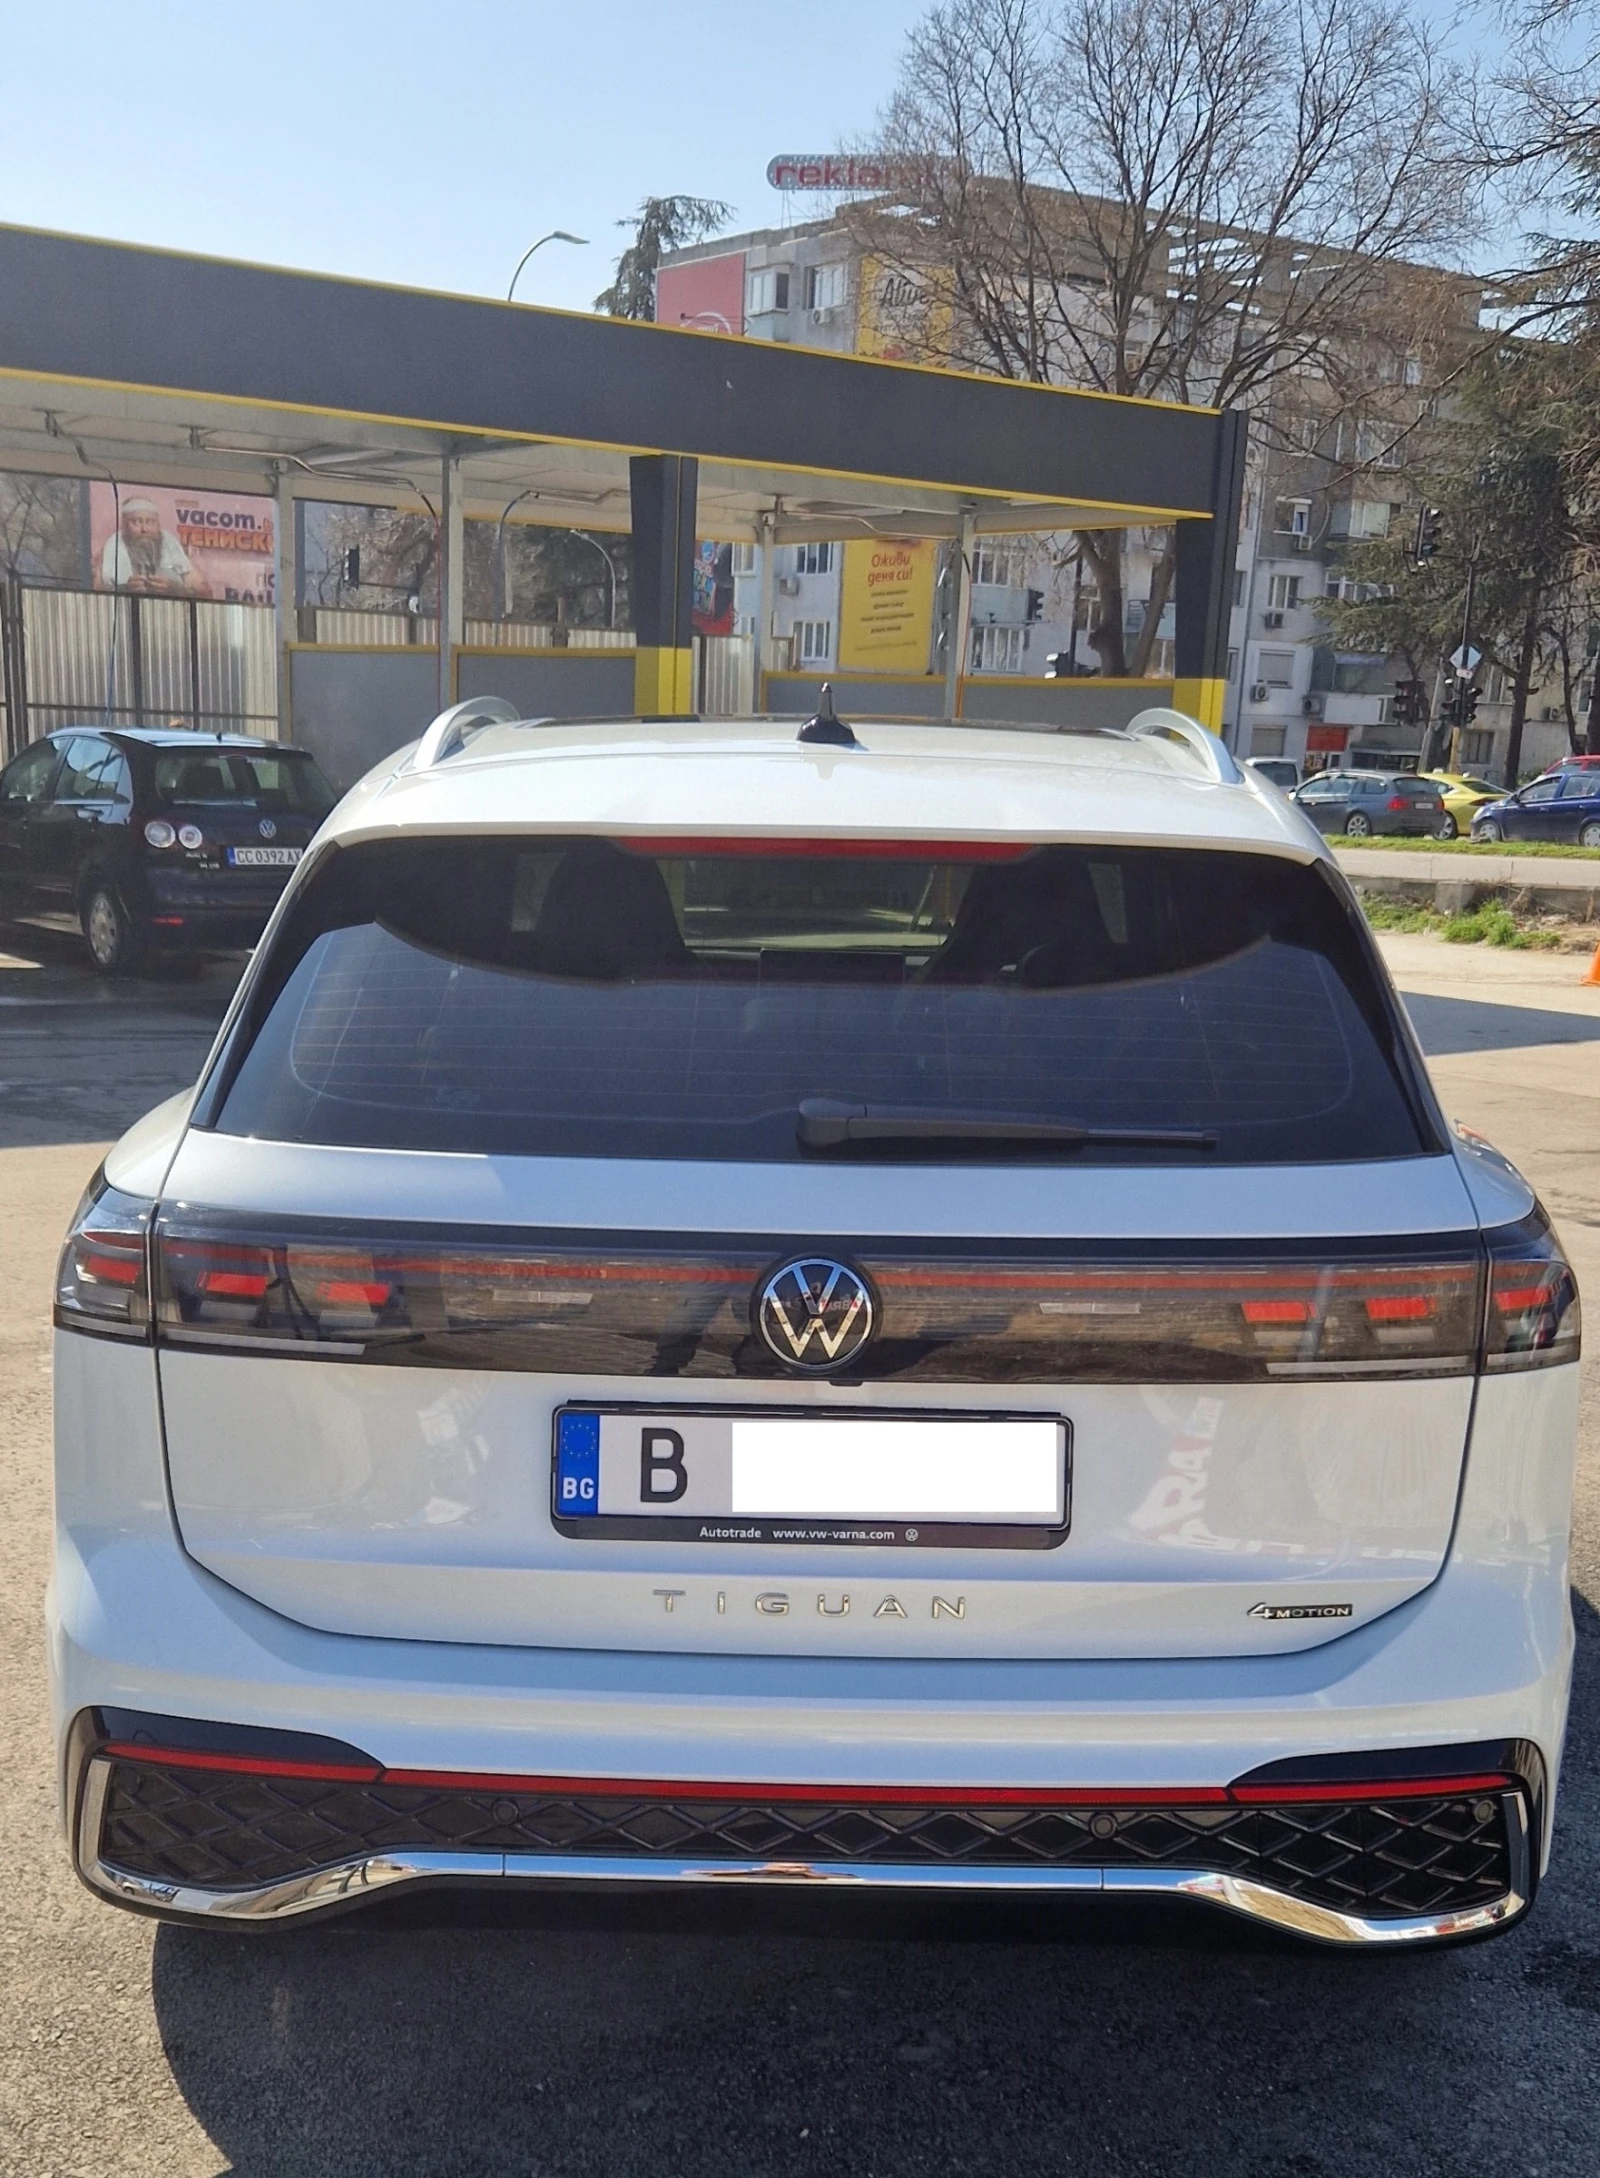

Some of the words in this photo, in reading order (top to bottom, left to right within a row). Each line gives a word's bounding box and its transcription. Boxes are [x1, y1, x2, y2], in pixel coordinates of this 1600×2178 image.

[237, 850, 253, 863] CC
[255, 850, 284, 863] 0392
[640, 1427, 688, 1504] B
[562, 1477, 595, 1500] BG
[699, 1526, 762, 1539] Autotrade
[772, 1529, 895, 1541] www.vw-varna.com
[653, 1589, 966, 1620] TIGUAN
[1247, 1602, 1350, 1619] 4MOTION
